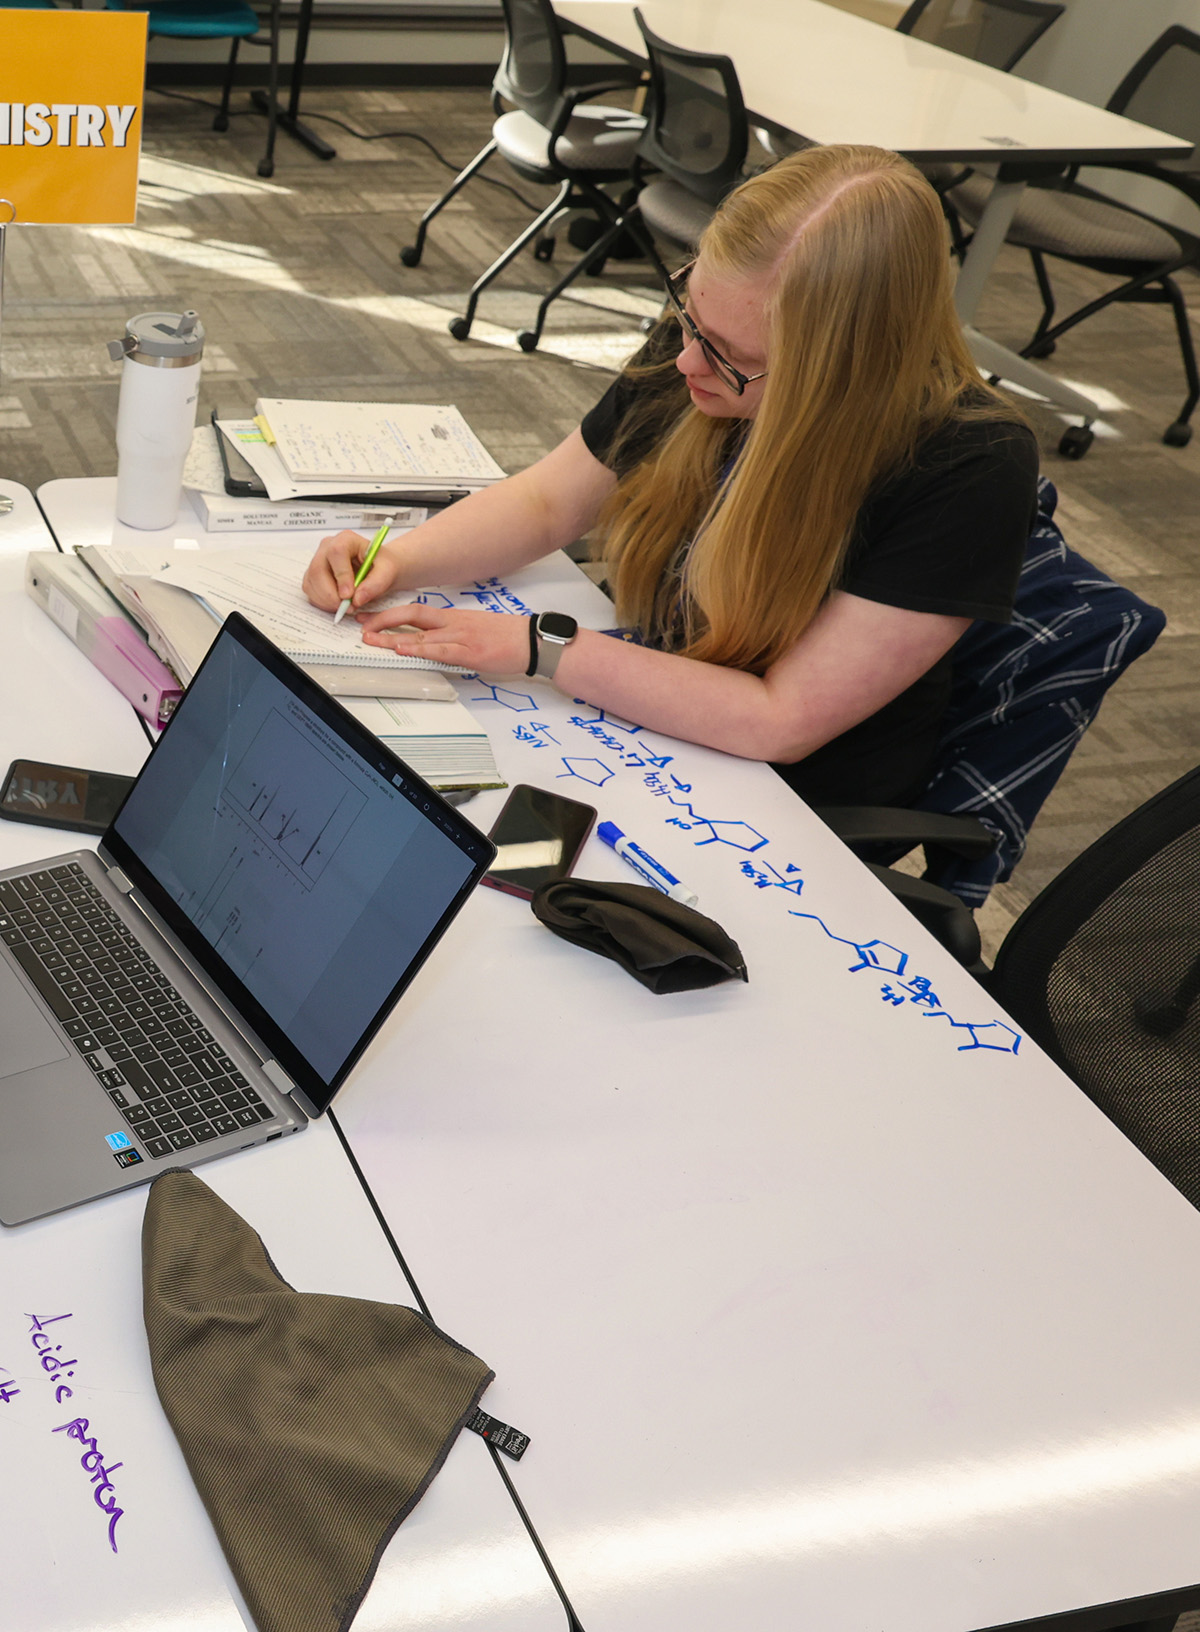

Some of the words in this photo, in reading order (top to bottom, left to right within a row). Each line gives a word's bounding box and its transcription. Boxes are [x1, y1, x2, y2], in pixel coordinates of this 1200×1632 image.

[283, 518, 327, 526] CHEMISTRY
[512, 724, 549, 748] NBS
[24, 1312, 78, 1404] Acidic
[51, 1417, 125, 1554] proton
